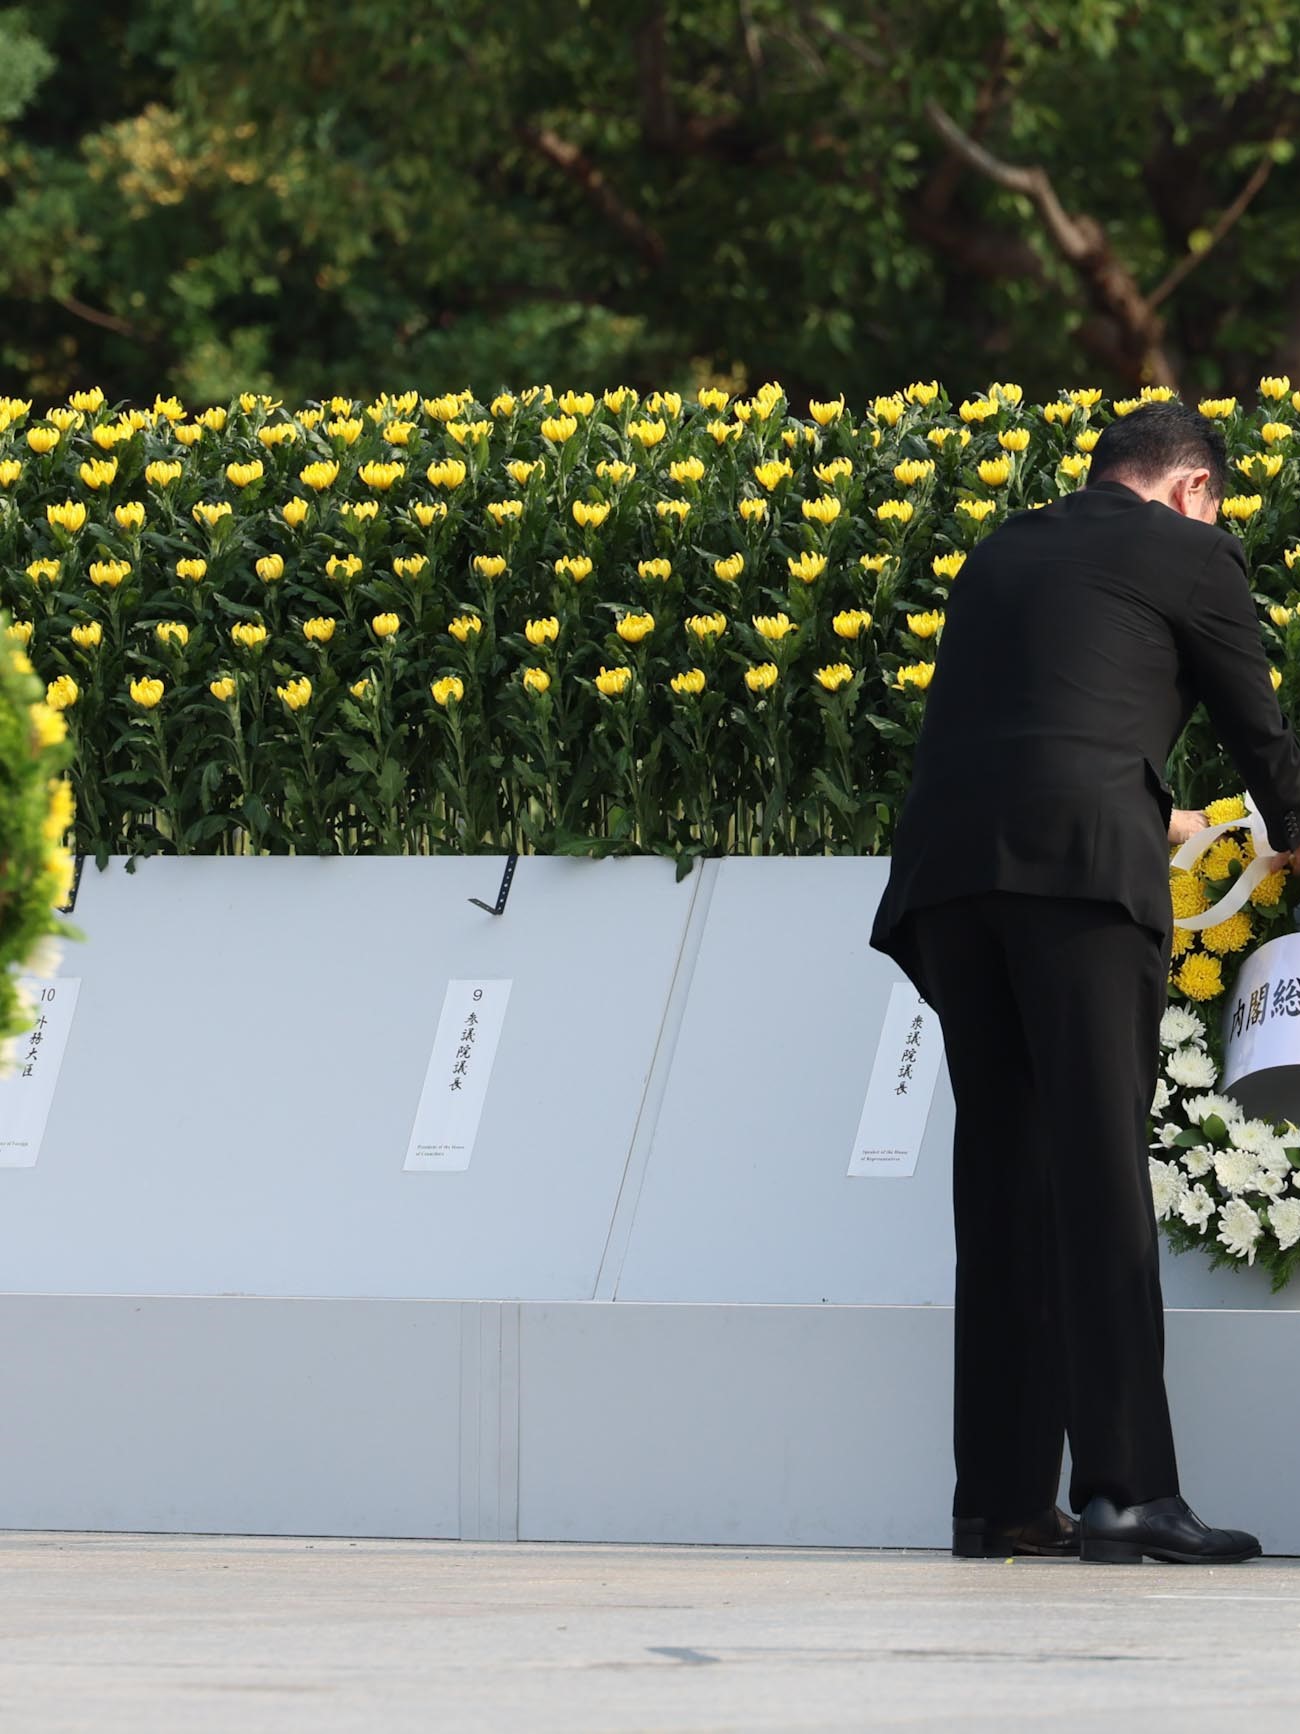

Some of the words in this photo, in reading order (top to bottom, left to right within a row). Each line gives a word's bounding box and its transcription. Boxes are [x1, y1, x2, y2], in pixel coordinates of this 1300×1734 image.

[41, 988, 56, 1002] 10
[472, 989, 483, 1002] 9
[449, 1011, 479, 1091] 参議院議長
[894, 1014, 924, 1096] 衆議院議長
